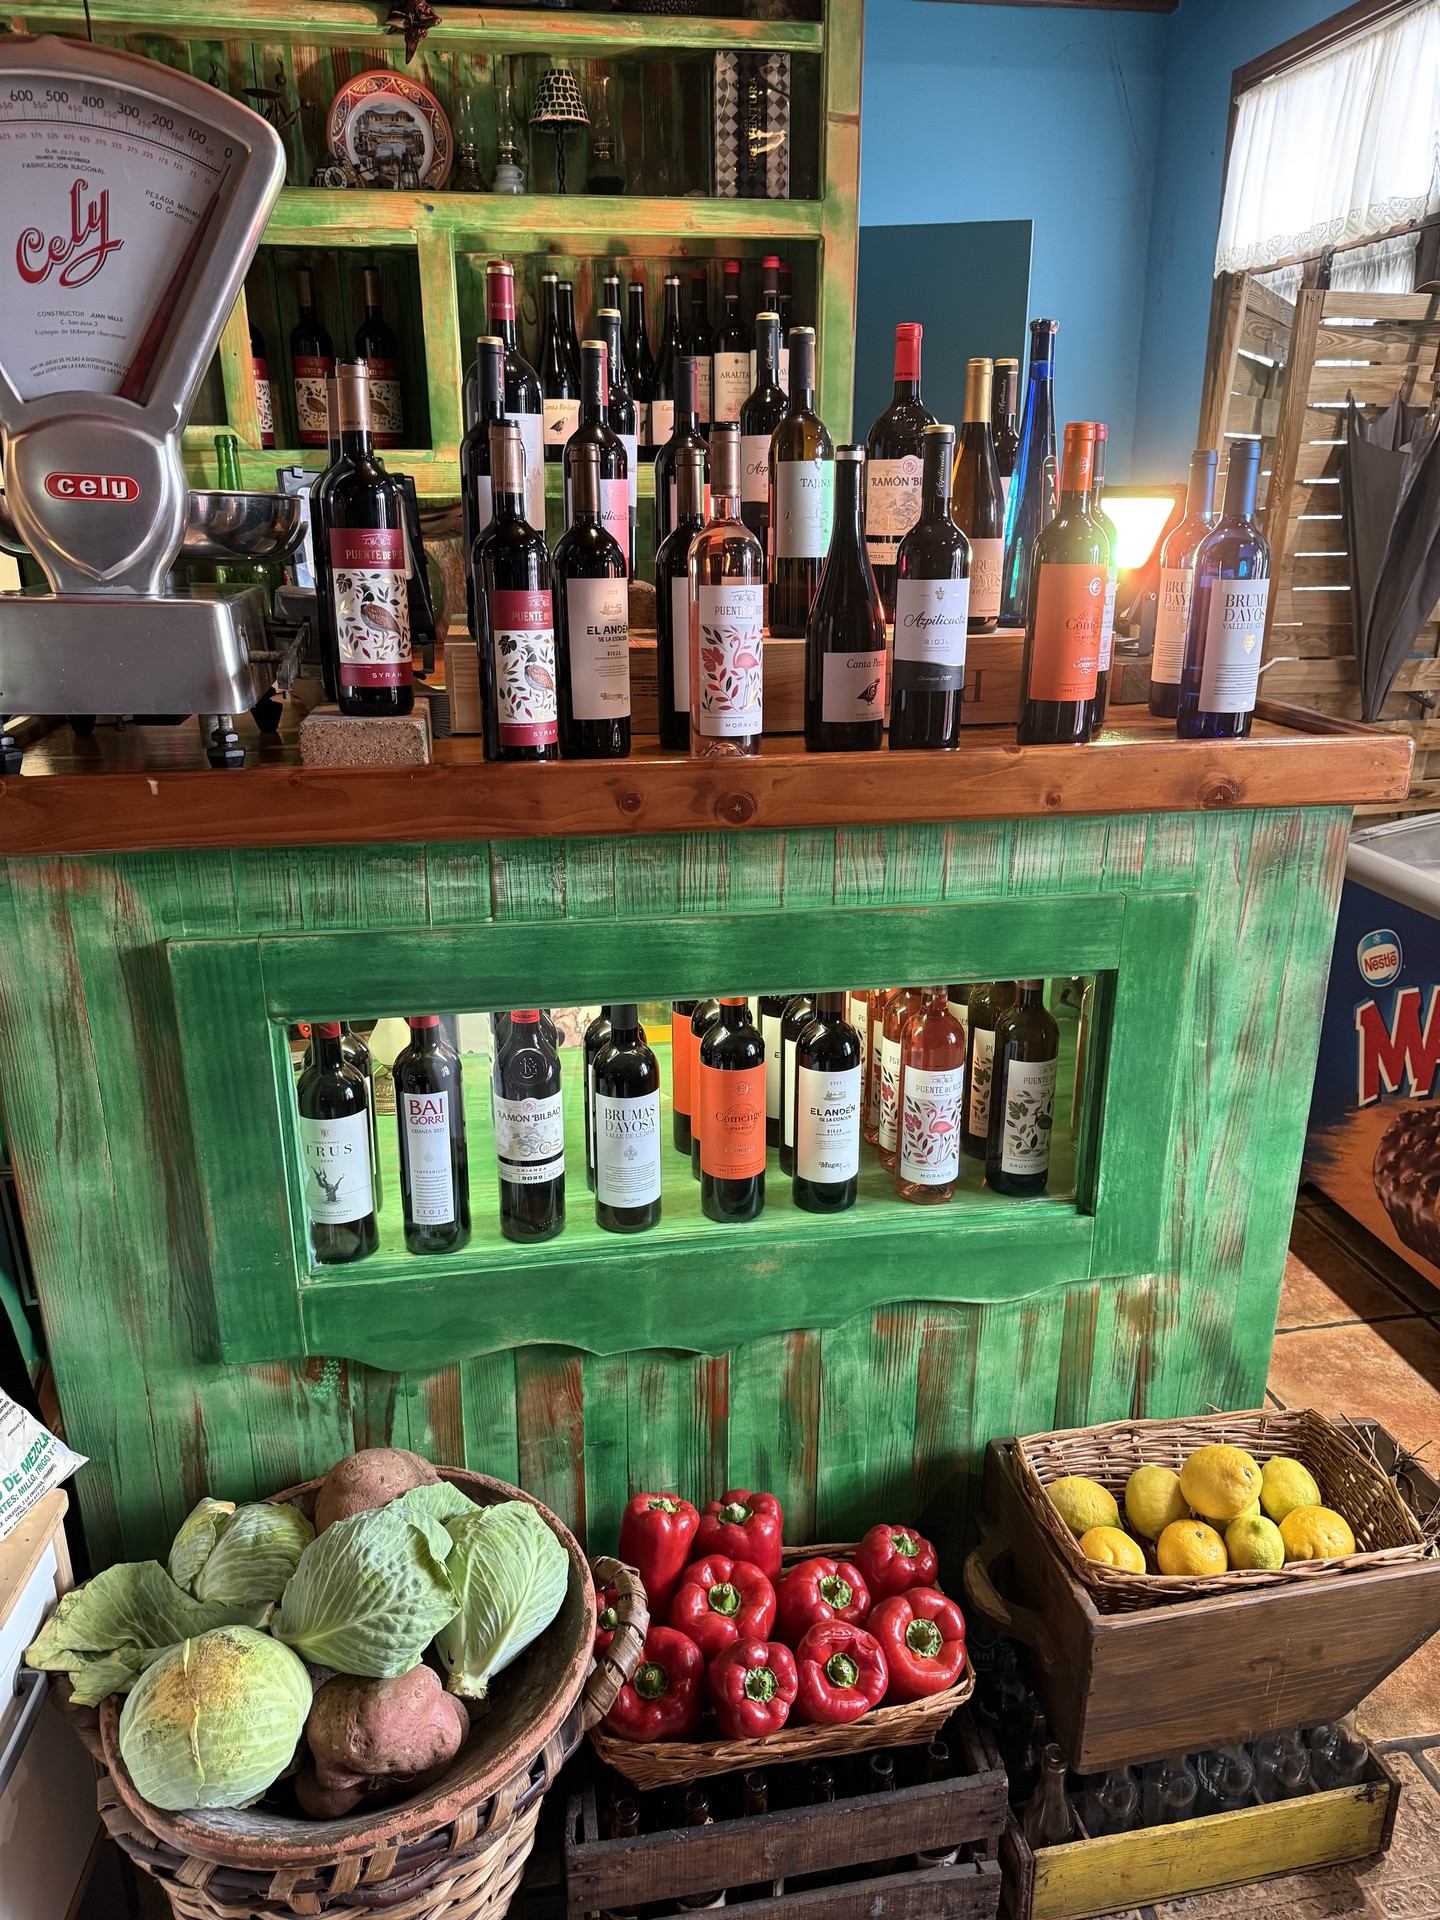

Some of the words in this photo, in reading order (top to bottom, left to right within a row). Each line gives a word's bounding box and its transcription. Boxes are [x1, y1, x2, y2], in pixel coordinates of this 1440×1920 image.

[10, 90, 34, 102] 600
[45, 89, 69, 104] 500
[81, 96, 105, 110] 400
[116, 102, 140, 119] 300
[151, 113, 174, 131] 200
[187, 127, 207, 145] 100
[224, 147, 233, 159] 0
[33, 100, 48, 109] 550
[68, 103, 83, 113] 450
[103, 109, 118, 119] 350
[137, 118, 152, 130] 250
[171, 130, 185, 142] 150
[205, 146, 215, 157] 50
[127, 145, 139, 154] 275
[190, 169, 198, 178] 75
[70, 164, 106, 175] NACIONAL
[145, 188, 175, 207] PESADA
[149, 199, 163, 211] 40
[165, 206, 194, 226] Gramos
[36, 310, 85, 318] CONSTRUCTOR
[57, 476, 129, 500] cely
[870, 474, 909, 488] RAMÓN
[345, 549, 382, 561] PUENTE
[382, 550, 392, 561] DE
[511, 610, 543, 623] PUENTE
[903, 610, 967, 630] Azpilicueta
[586, 625, 602, 636] EL
[1222, 622, 1246, 630] VALLE
[597, 635, 606, 643] DE
[605, 635, 613, 643] LA
[846, 658, 872, 669] Canta
[1363, 950, 1399, 974] Nestlé
[1022, 1075, 1050, 1086] PUENTE
[915, 1083, 944, 1095] PUENTE
[408, 1097, 444, 1116] BAI
[604, 1104, 656, 1122] BRUMAS
[810, 1106, 823, 1117] EL
[823, 1103, 857, 1117] ANDÉN
[409, 1114, 445, 1126] GORRI
[497, 1109, 531, 1124] RAMÓN
[531, 1106, 562, 1124] BILBAO
[625, 1132, 635, 1140] DE
[516, 1166, 548, 1174] CRIANZA
[415, 1208, 450, 1216] RIOJA
[1, 1472, 24, 1492] DE
[20, 1430, 52, 1475] MEZCLA
[34, 1454, 51, 1475] TRIGO
